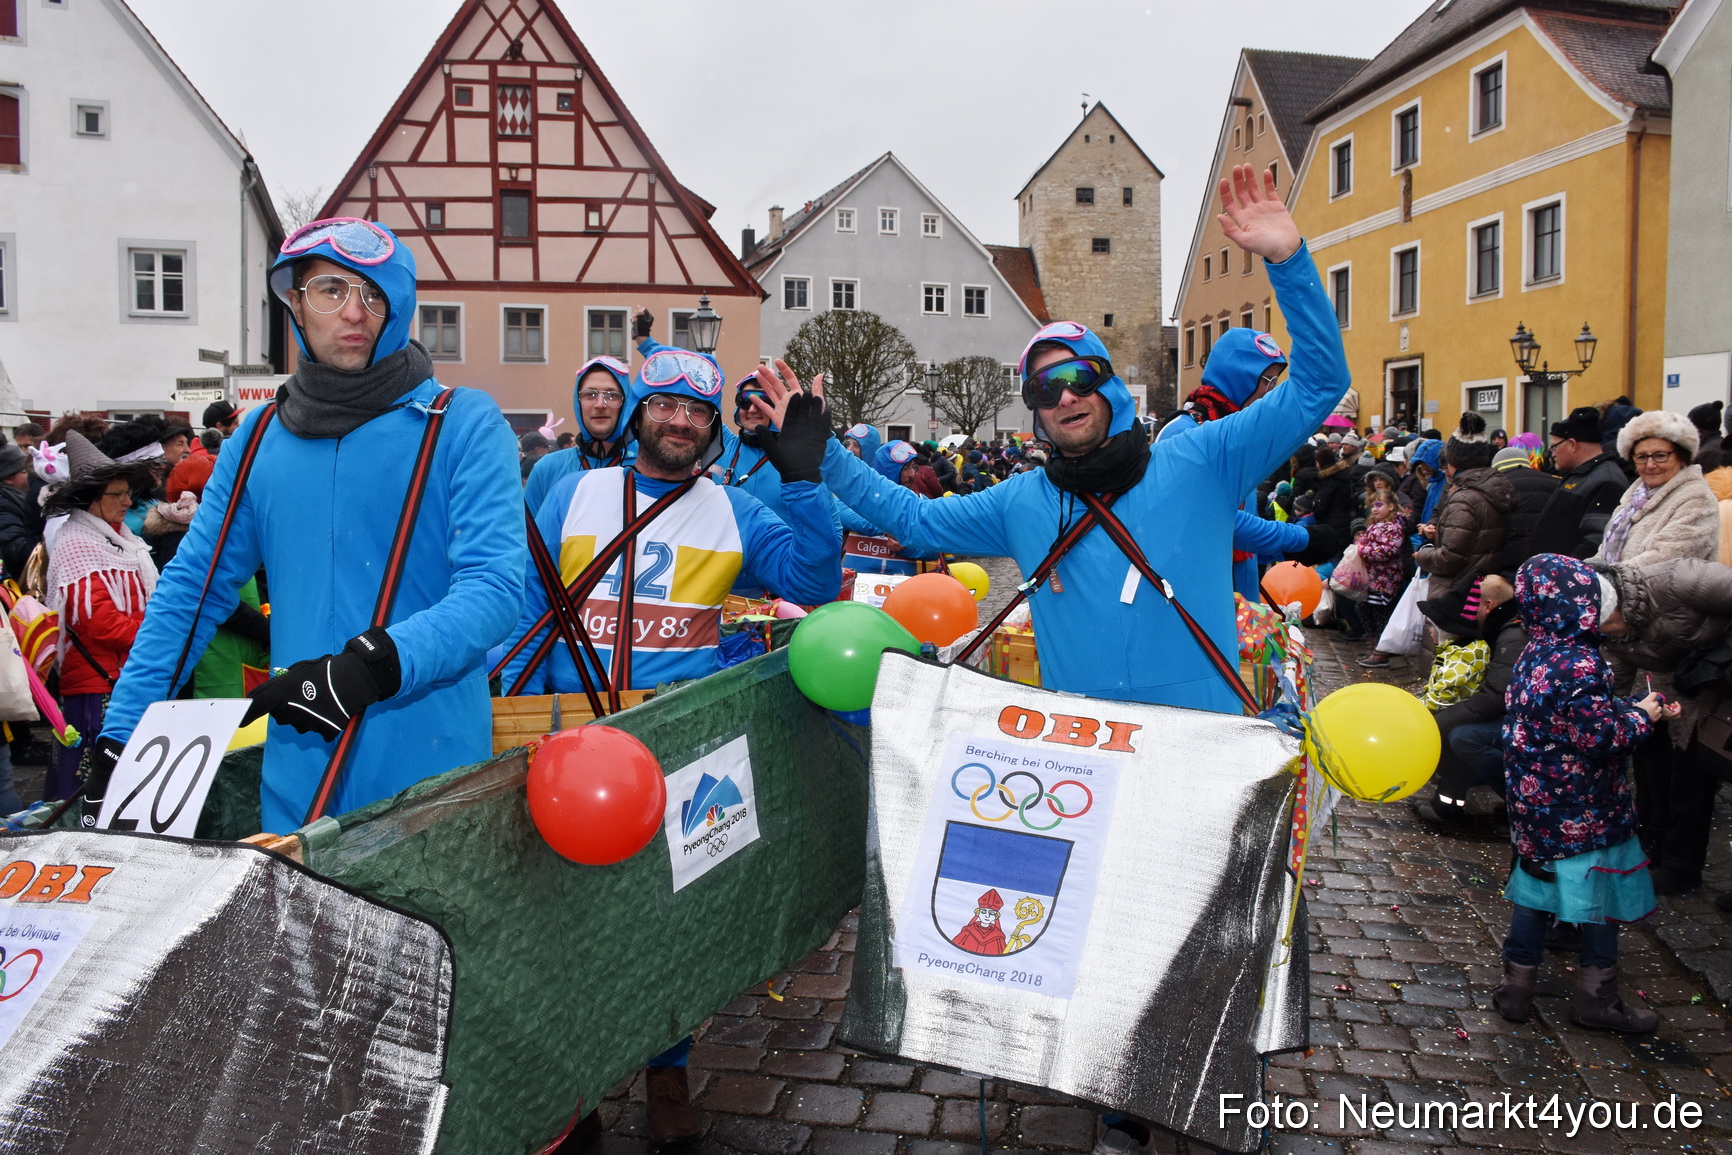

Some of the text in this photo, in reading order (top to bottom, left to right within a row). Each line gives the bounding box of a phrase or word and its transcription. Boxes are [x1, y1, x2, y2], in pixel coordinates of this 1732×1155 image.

[232, 366, 270, 375] Probststraße
[1480, 391, 1497, 402] BW
[659, 616, 691, 639] 88
[998, 705, 1142, 753] OBI
[965, 745, 1093, 776] Berching bei Olympia
[107, 735, 212, 833] 20
[683, 808, 747, 856] PyeongChang 2018
[0, 860, 115, 904] OBI
[5, 923, 19, 937] bei
[21, 924, 61, 942] Olympia
[918, 952, 1043, 987] PyeongChang 2018
